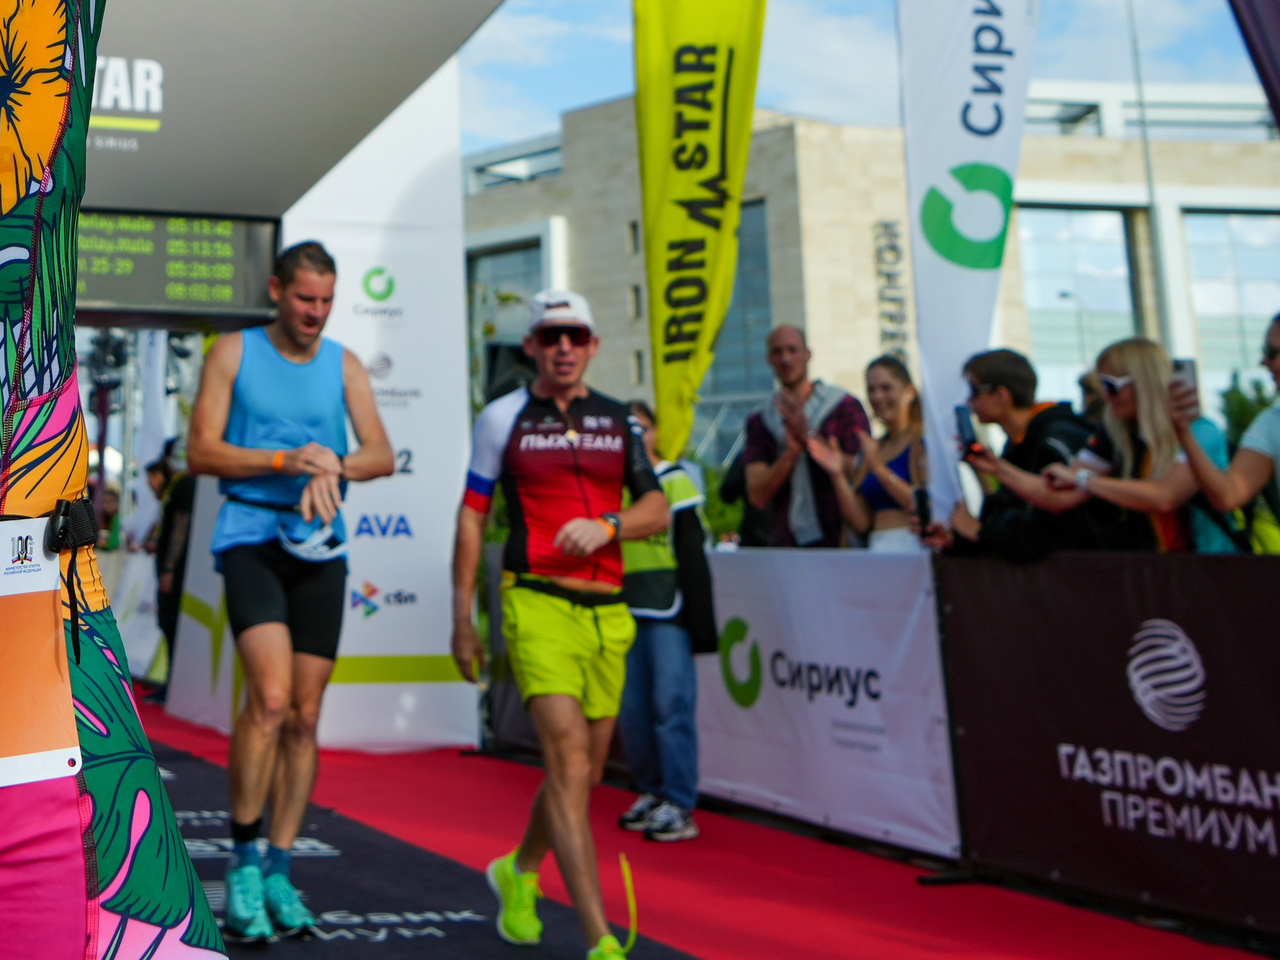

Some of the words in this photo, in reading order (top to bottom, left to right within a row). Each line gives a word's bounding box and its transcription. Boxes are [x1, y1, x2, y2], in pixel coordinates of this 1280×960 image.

[91, 55, 165, 114] TAR
[672, 43, 718, 171] STAR
[663, 237, 708, 366] IRON
[396, 449, 414, 475] 2
[354, 514, 414, 538] AVA
[771, 649, 882, 708] Сириус
[1057, 743, 1280, 811] ГАЗПРОМБАН
[1100, 790, 1279, 857] ПРЕМИУМ
